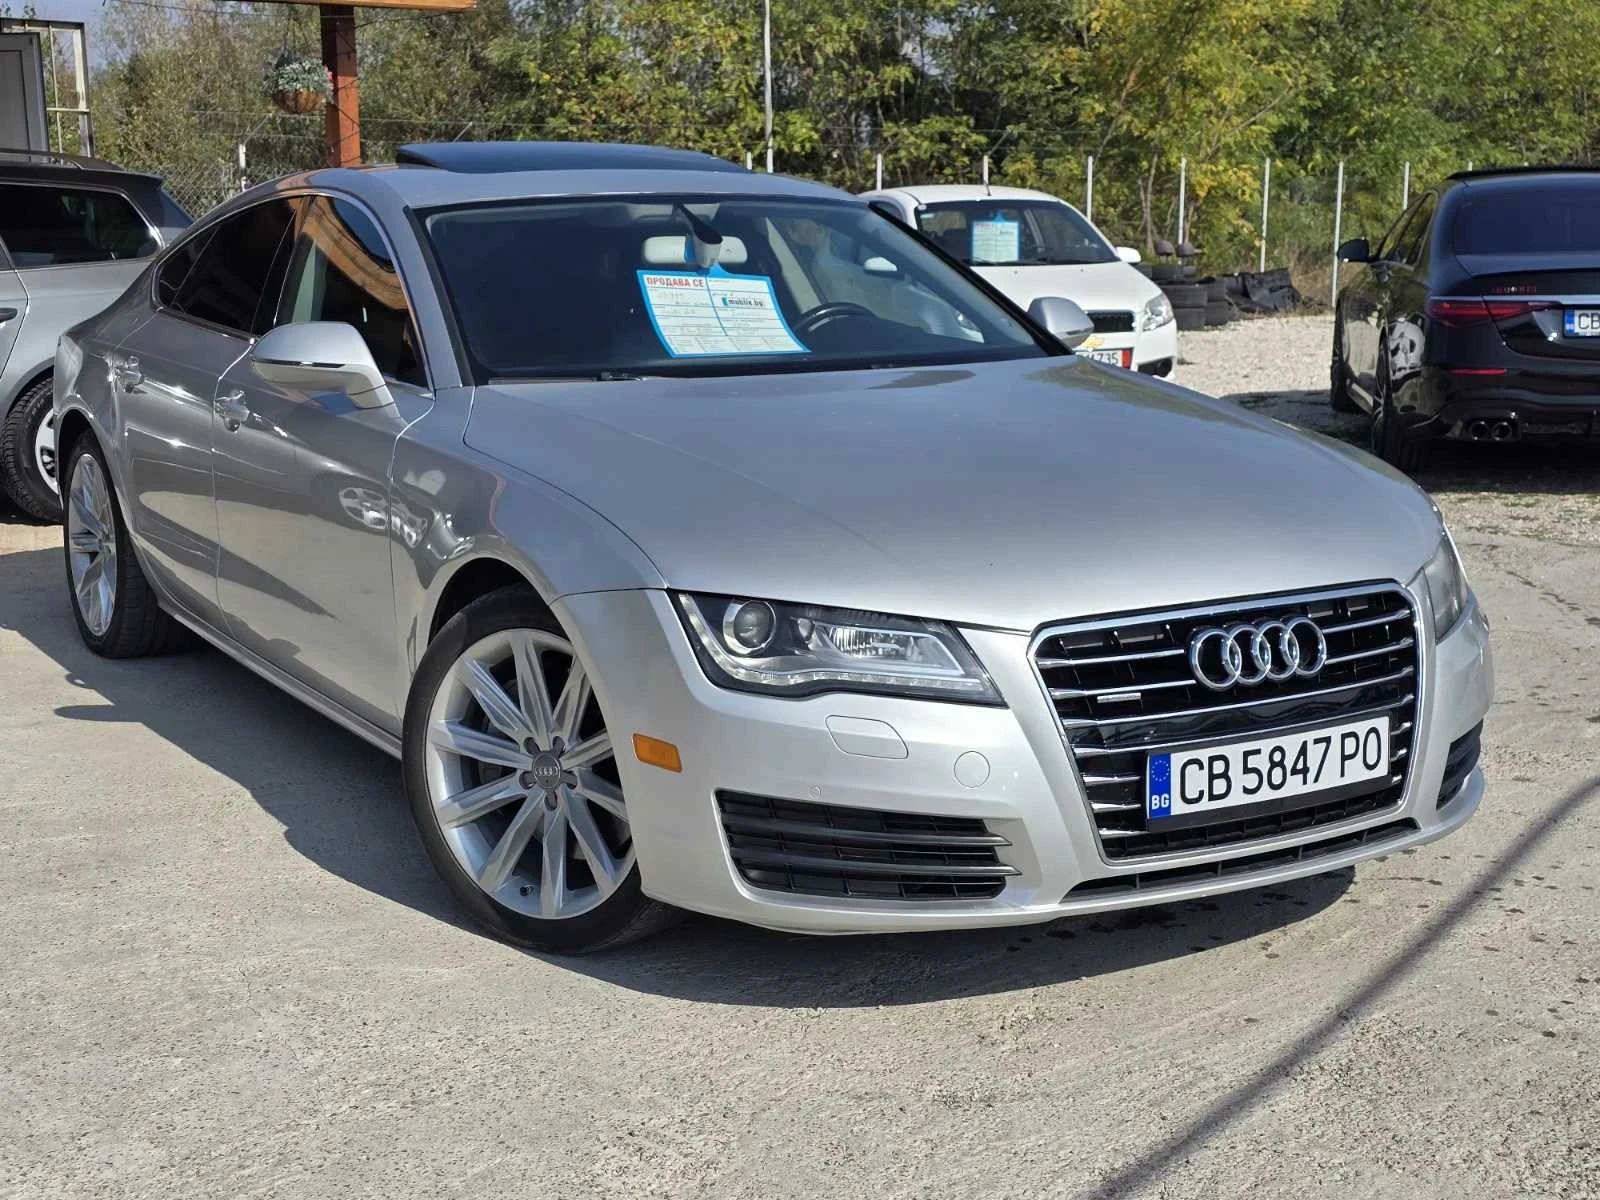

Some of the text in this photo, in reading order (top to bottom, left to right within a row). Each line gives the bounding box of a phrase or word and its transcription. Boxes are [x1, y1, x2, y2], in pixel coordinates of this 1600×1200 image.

[646, 277, 690, 287] ПРОДАВА
[693, 279, 704, 288] СЕ
[1179, 726, 1382, 805] CB 5847 PO
[1151, 793, 1170, 811] BG
